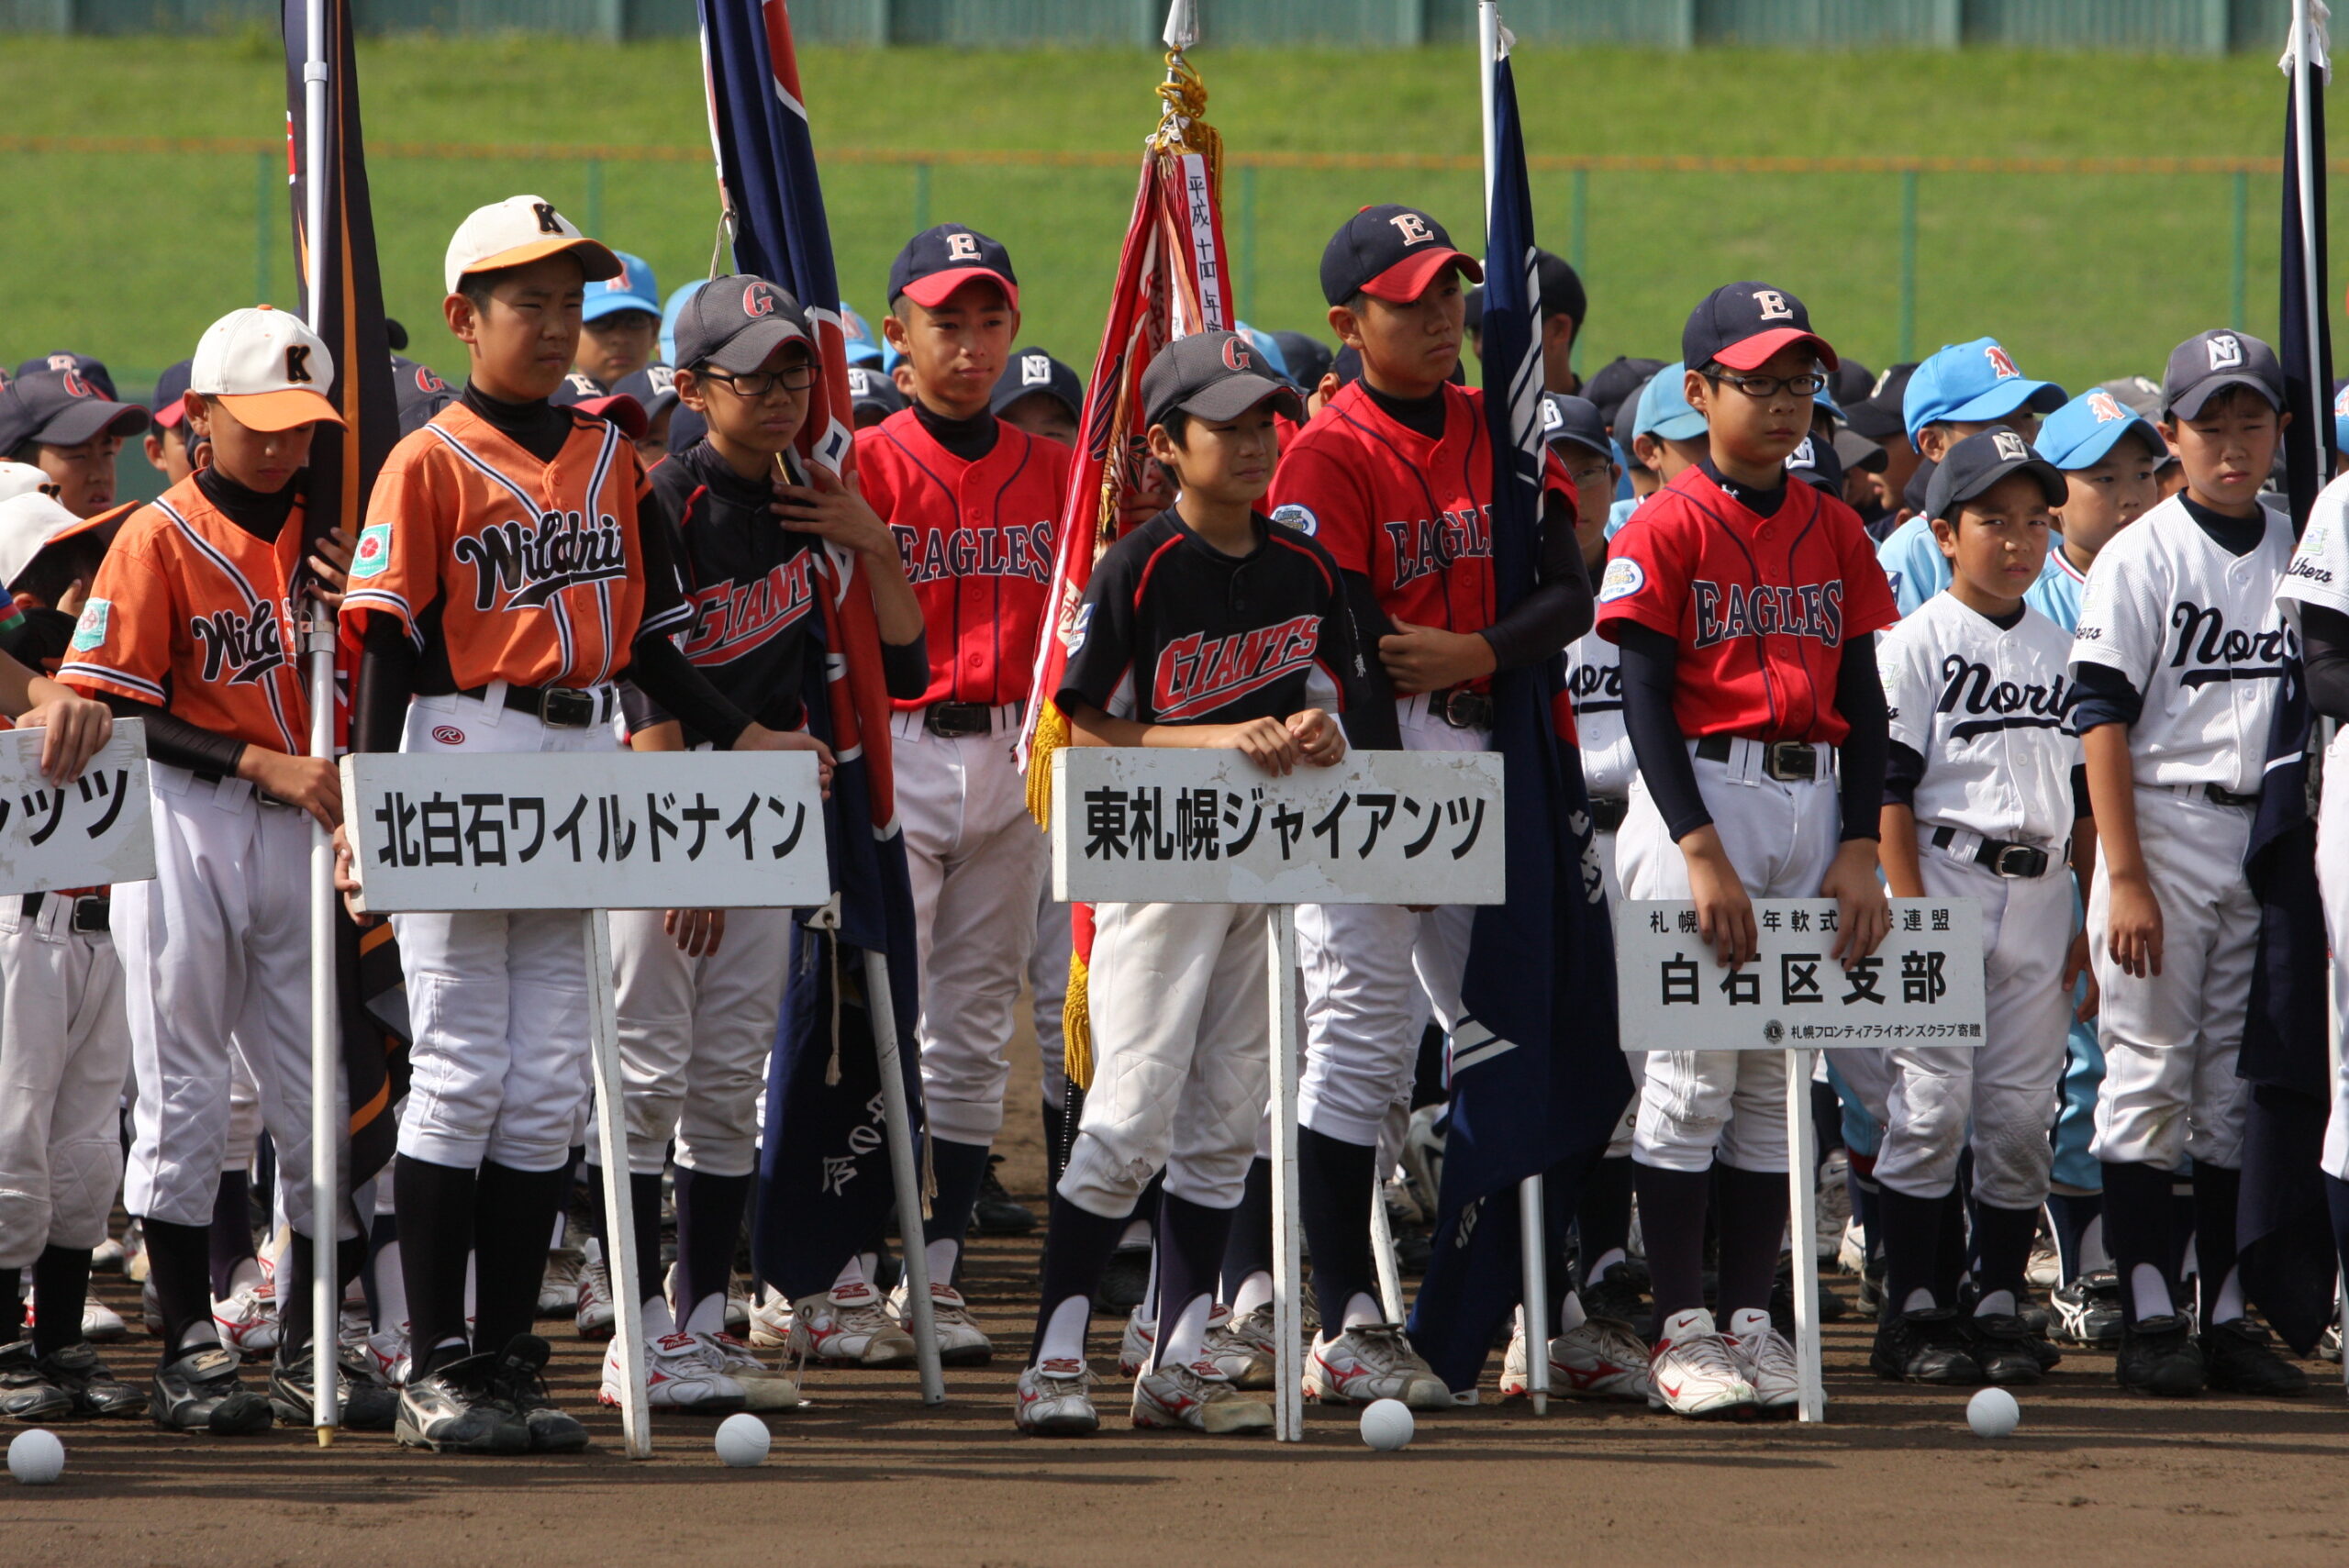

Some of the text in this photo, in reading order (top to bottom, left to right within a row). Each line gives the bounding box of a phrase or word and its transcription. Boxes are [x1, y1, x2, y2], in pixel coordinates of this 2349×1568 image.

[532, 203, 564, 236] K
[1390, 213, 1434, 247] E
[945, 233, 982, 261] E
[742, 282, 774, 318] G
[1753, 290, 1794, 321] E
[285, 345, 313, 384] K
[1221, 336, 1252, 372] G
[415, 365, 446, 394] G
[564, 373, 604, 397] E
[454, 510, 626, 611] Wildni
[888, 520, 1054, 585] EAGLES
[1384, 505, 1494, 591] EAGL
[688, 546, 813, 647] GIANT
[1690, 579, 1843, 651] EAGLES
[2170, 601, 2288, 668] Nor
[1152, 614, 1325, 713] GIANTS
[374, 791, 807, 868] 北白石ワイルドナイン
[1084, 785, 1486, 862] 東札幌ジャイアンツ
[1650, 908, 1951, 934] 札幌年軟式連盟
[1660, 950, 1947, 1006] 白石区支部
[1790, 1023, 1983, 1040] 札幌フロンティアライオンズクラブ寄贈
